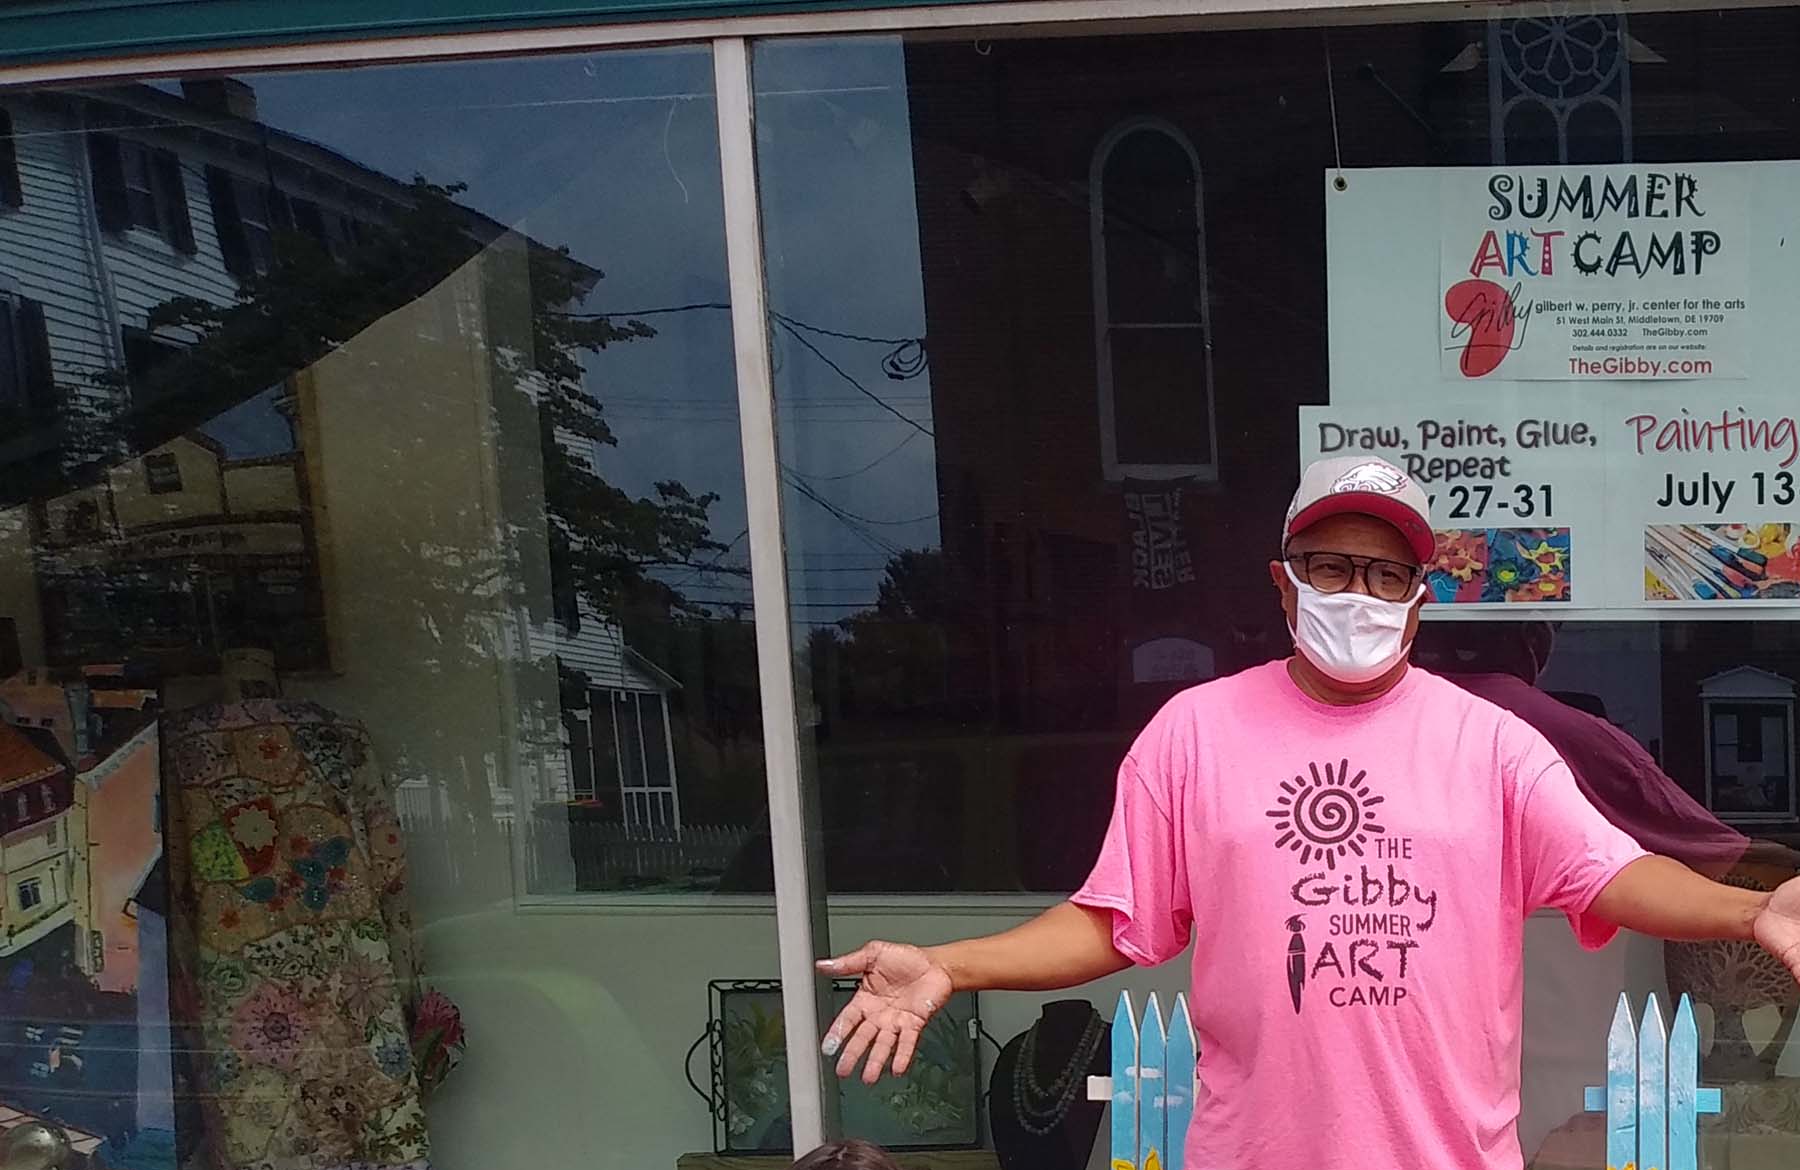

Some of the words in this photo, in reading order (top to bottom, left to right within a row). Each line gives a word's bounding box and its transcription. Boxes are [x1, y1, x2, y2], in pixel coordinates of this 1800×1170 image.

[1488, 172, 1706, 223] SUMMER
[1469, 227, 1565, 278] ART
[1570, 230, 1721, 279] CAMP
[1536, 301, 1572, 314] gilbert
[1643, 301, 1680, 311] center
[1683, 299, 1699, 310] for
[1702, 299, 1720, 310] the
[1724, 299, 1746, 310] arts
[1556, 316, 1565, 325] 51
[1569, 316, 1589, 325] West
[1592, 316, 1614, 325] Main
[1685, 315, 1696, 323] DE
[1699, 314, 1724, 323] 19709
[1572, 328, 1628, 338] 302.444.0332
[1642, 327, 1708, 338] TheGibby.com
[1595, 344, 1608, 352] and
[1569, 357, 1712, 377] TheGibby.com
[1319, 421, 1408, 452] Draw,
[1417, 419, 1506, 450] Paint,
[1516, 418, 1597, 448] Glue,
[1625, 406, 1799, 468] Painting
[1400, 453, 1512, 483] Repeat
[1448, 484, 1552, 519] 27-31
[1656, 471, 1736, 514] July
[1374, 838, 1412, 859] THE
[1290, 864, 1437, 931] Gibby
[1329, 913, 1411, 936] SUMMER
[1311, 939, 1420, 982] ART
[1329, 986, 1407, 1007] CAMP
